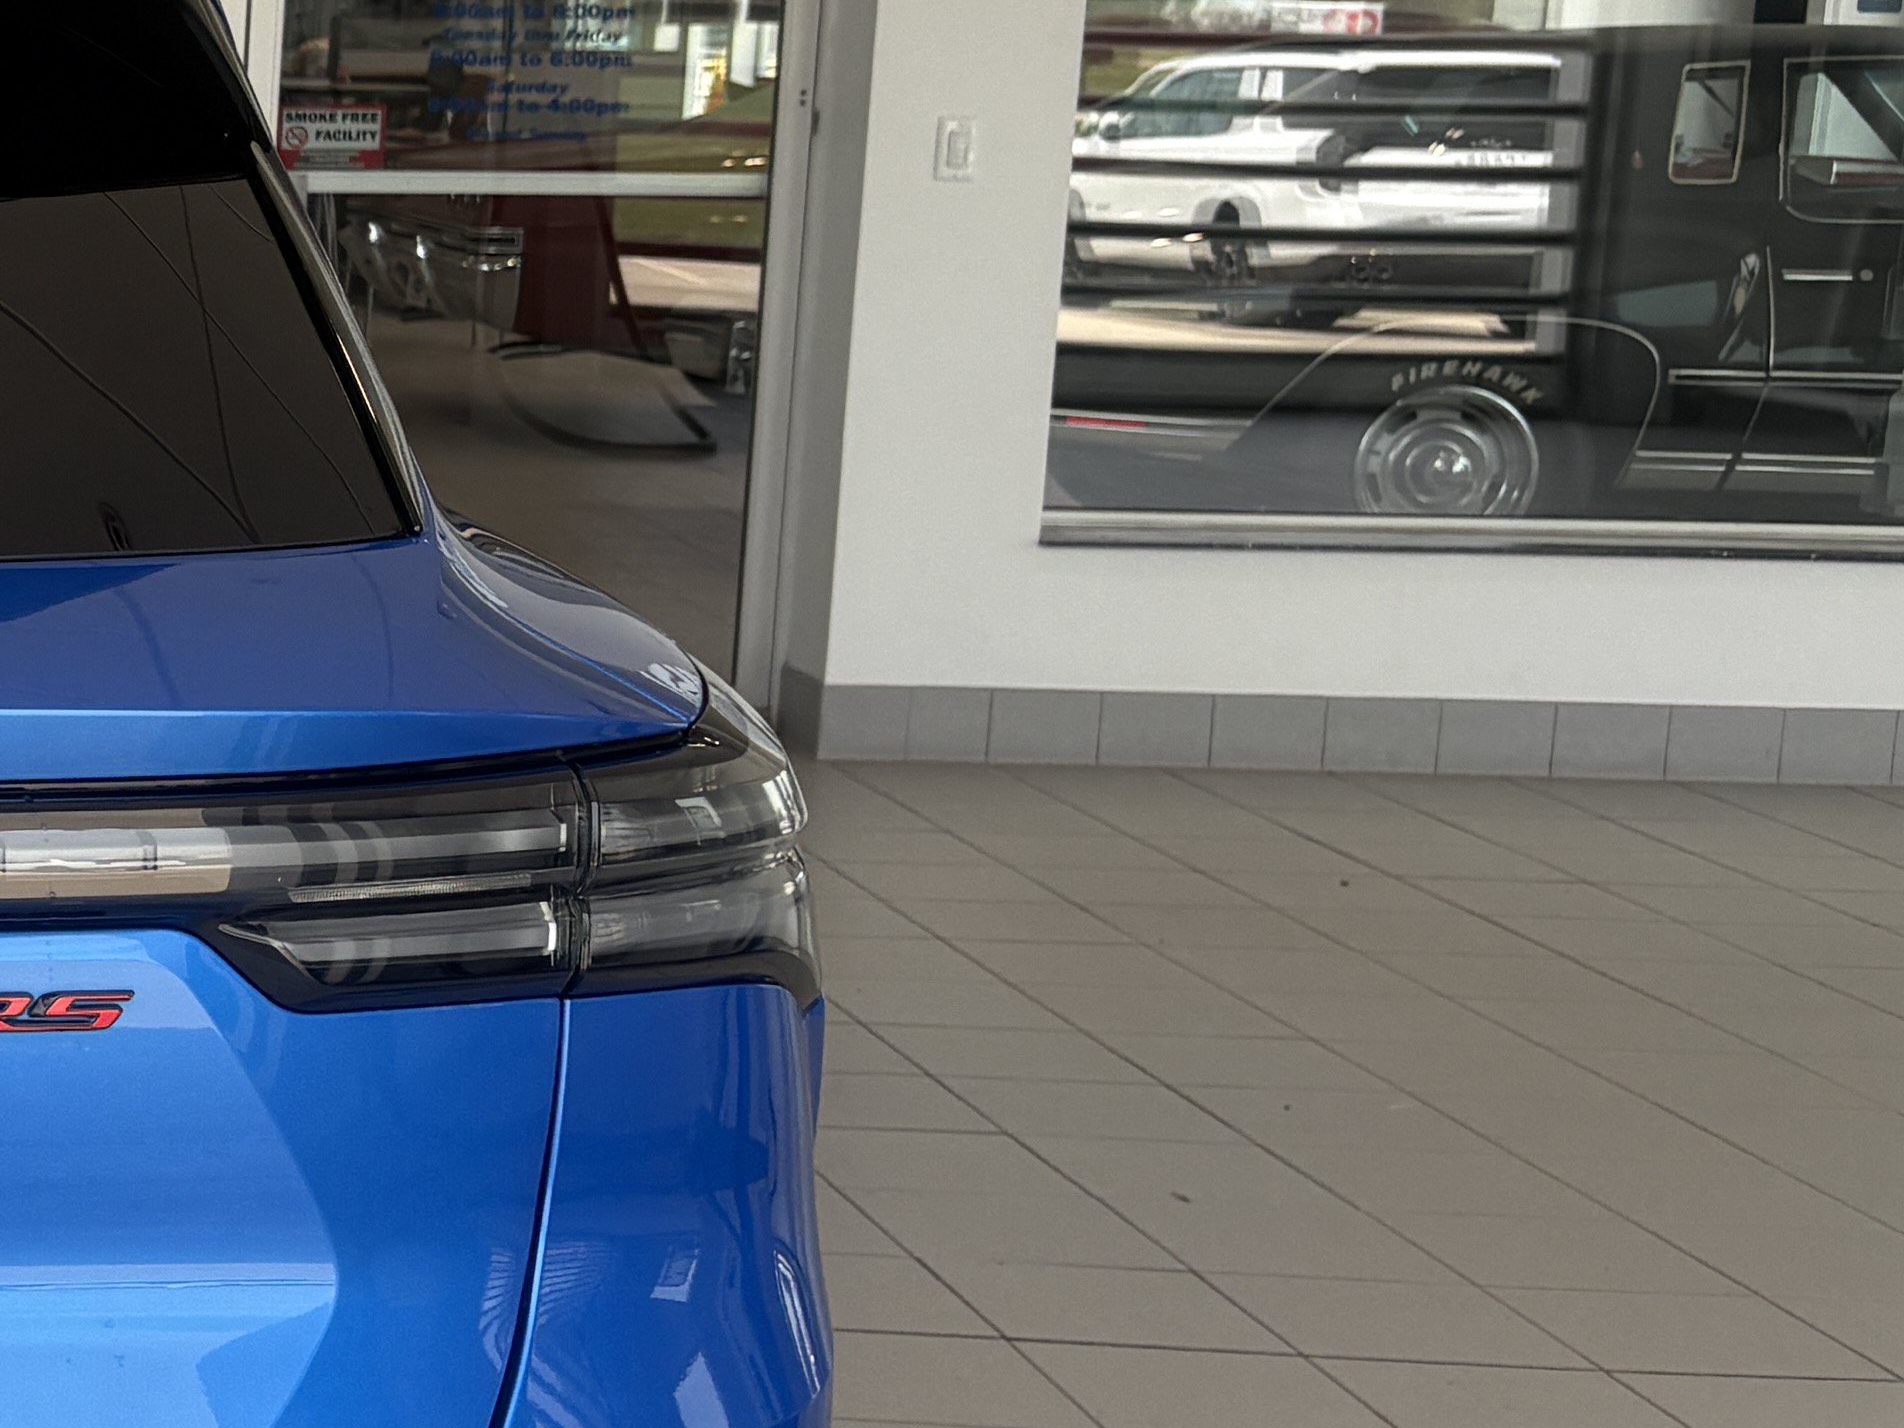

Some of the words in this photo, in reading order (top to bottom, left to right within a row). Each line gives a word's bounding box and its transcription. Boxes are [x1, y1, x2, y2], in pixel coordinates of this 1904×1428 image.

[520, 51, 542, 67] to
[487, 80, 570, 97] Saturday
[517, 98, 540, 114] to
[286, 112, 340, 123] SMOKE
[343, 112, 380, 123] FREE
[314, 129, 379, 143] FACILITY
[1391, 358, 1542, 405] FIREHAWK
